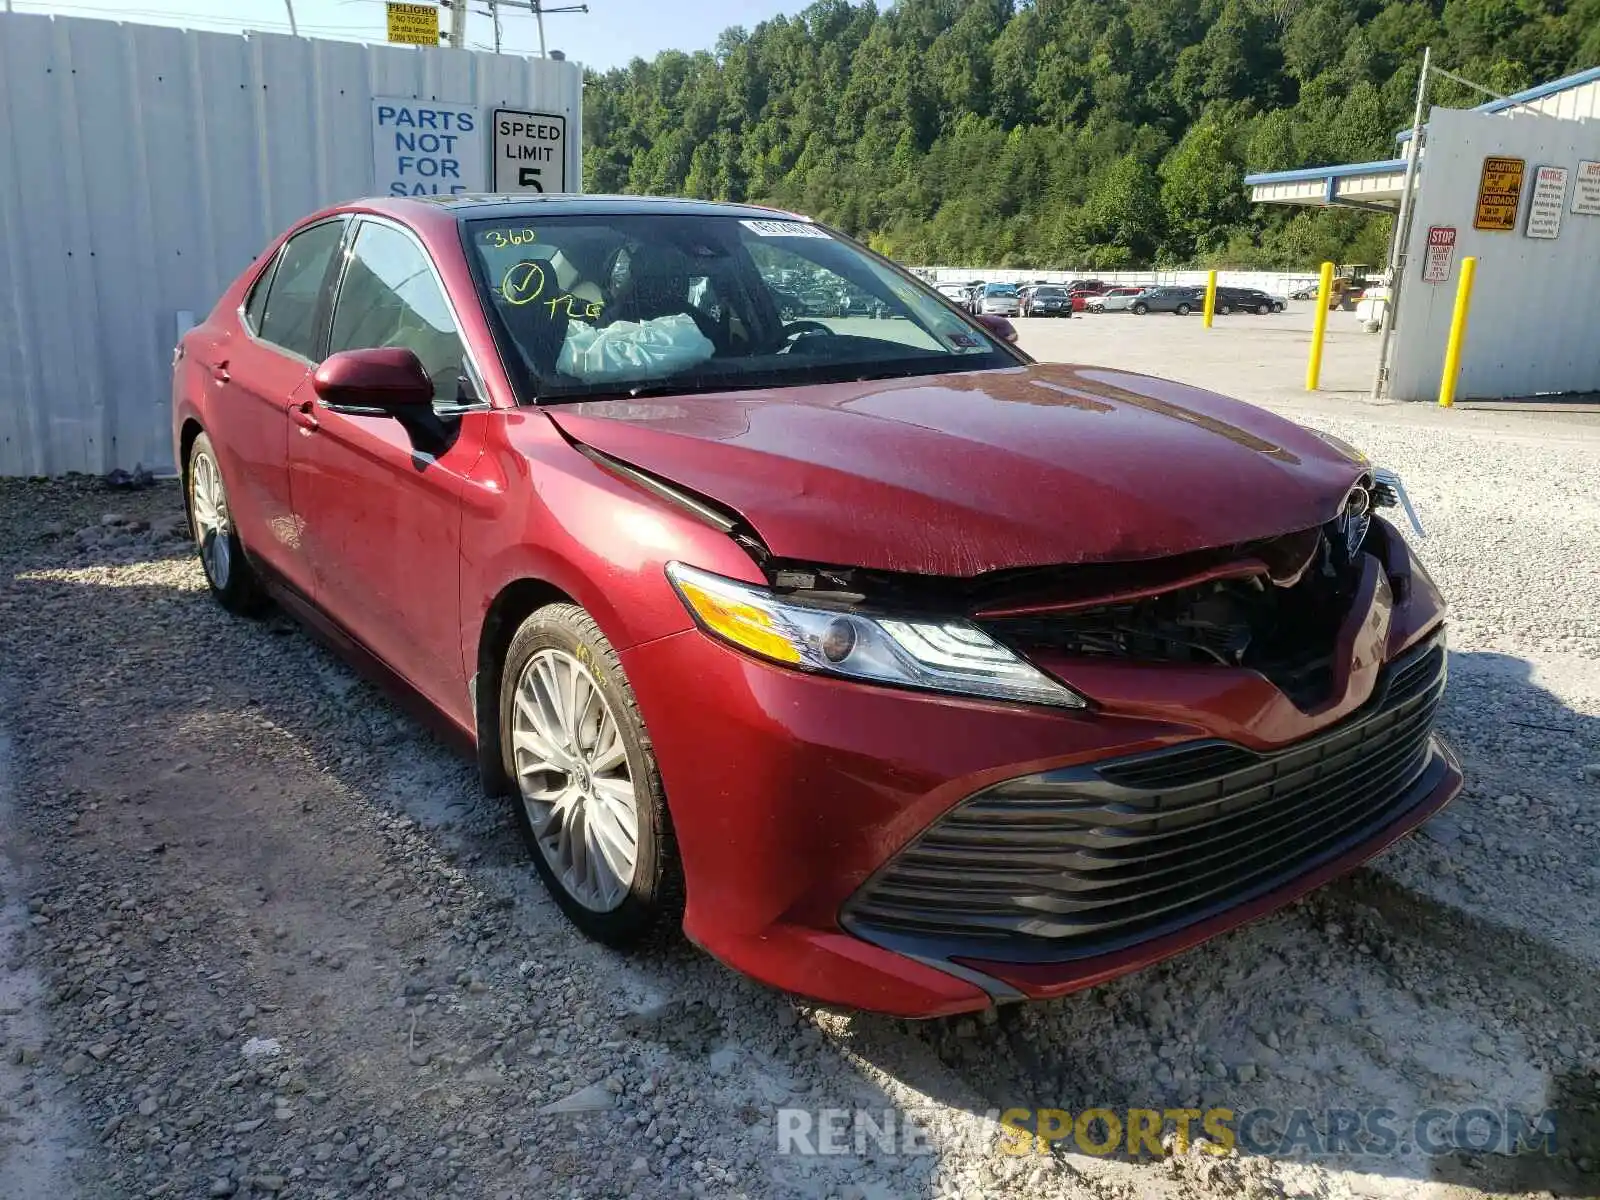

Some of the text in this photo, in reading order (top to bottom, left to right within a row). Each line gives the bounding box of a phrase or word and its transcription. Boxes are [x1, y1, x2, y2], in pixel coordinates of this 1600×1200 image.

[389, 3, 436, 15] PELIGRO
[378, 106, 474, 131] PARTS
[500, 121, 560, 140] SPEED
[395, 132, 458, 154] NOT
[506, 144, 554, 161] LIMIT
[398, 156, 460, 178] FOR
[1488, 161, 1521, 173] CAUTION
[1541, 169, 1563, 181] NOTICE
[518, 167, 543, 193] 5
[1484, 195, 1516, 205] CUIDADO
[486, 229, 535, 248] 360
[1431, 230, 1455, 243] STOP
